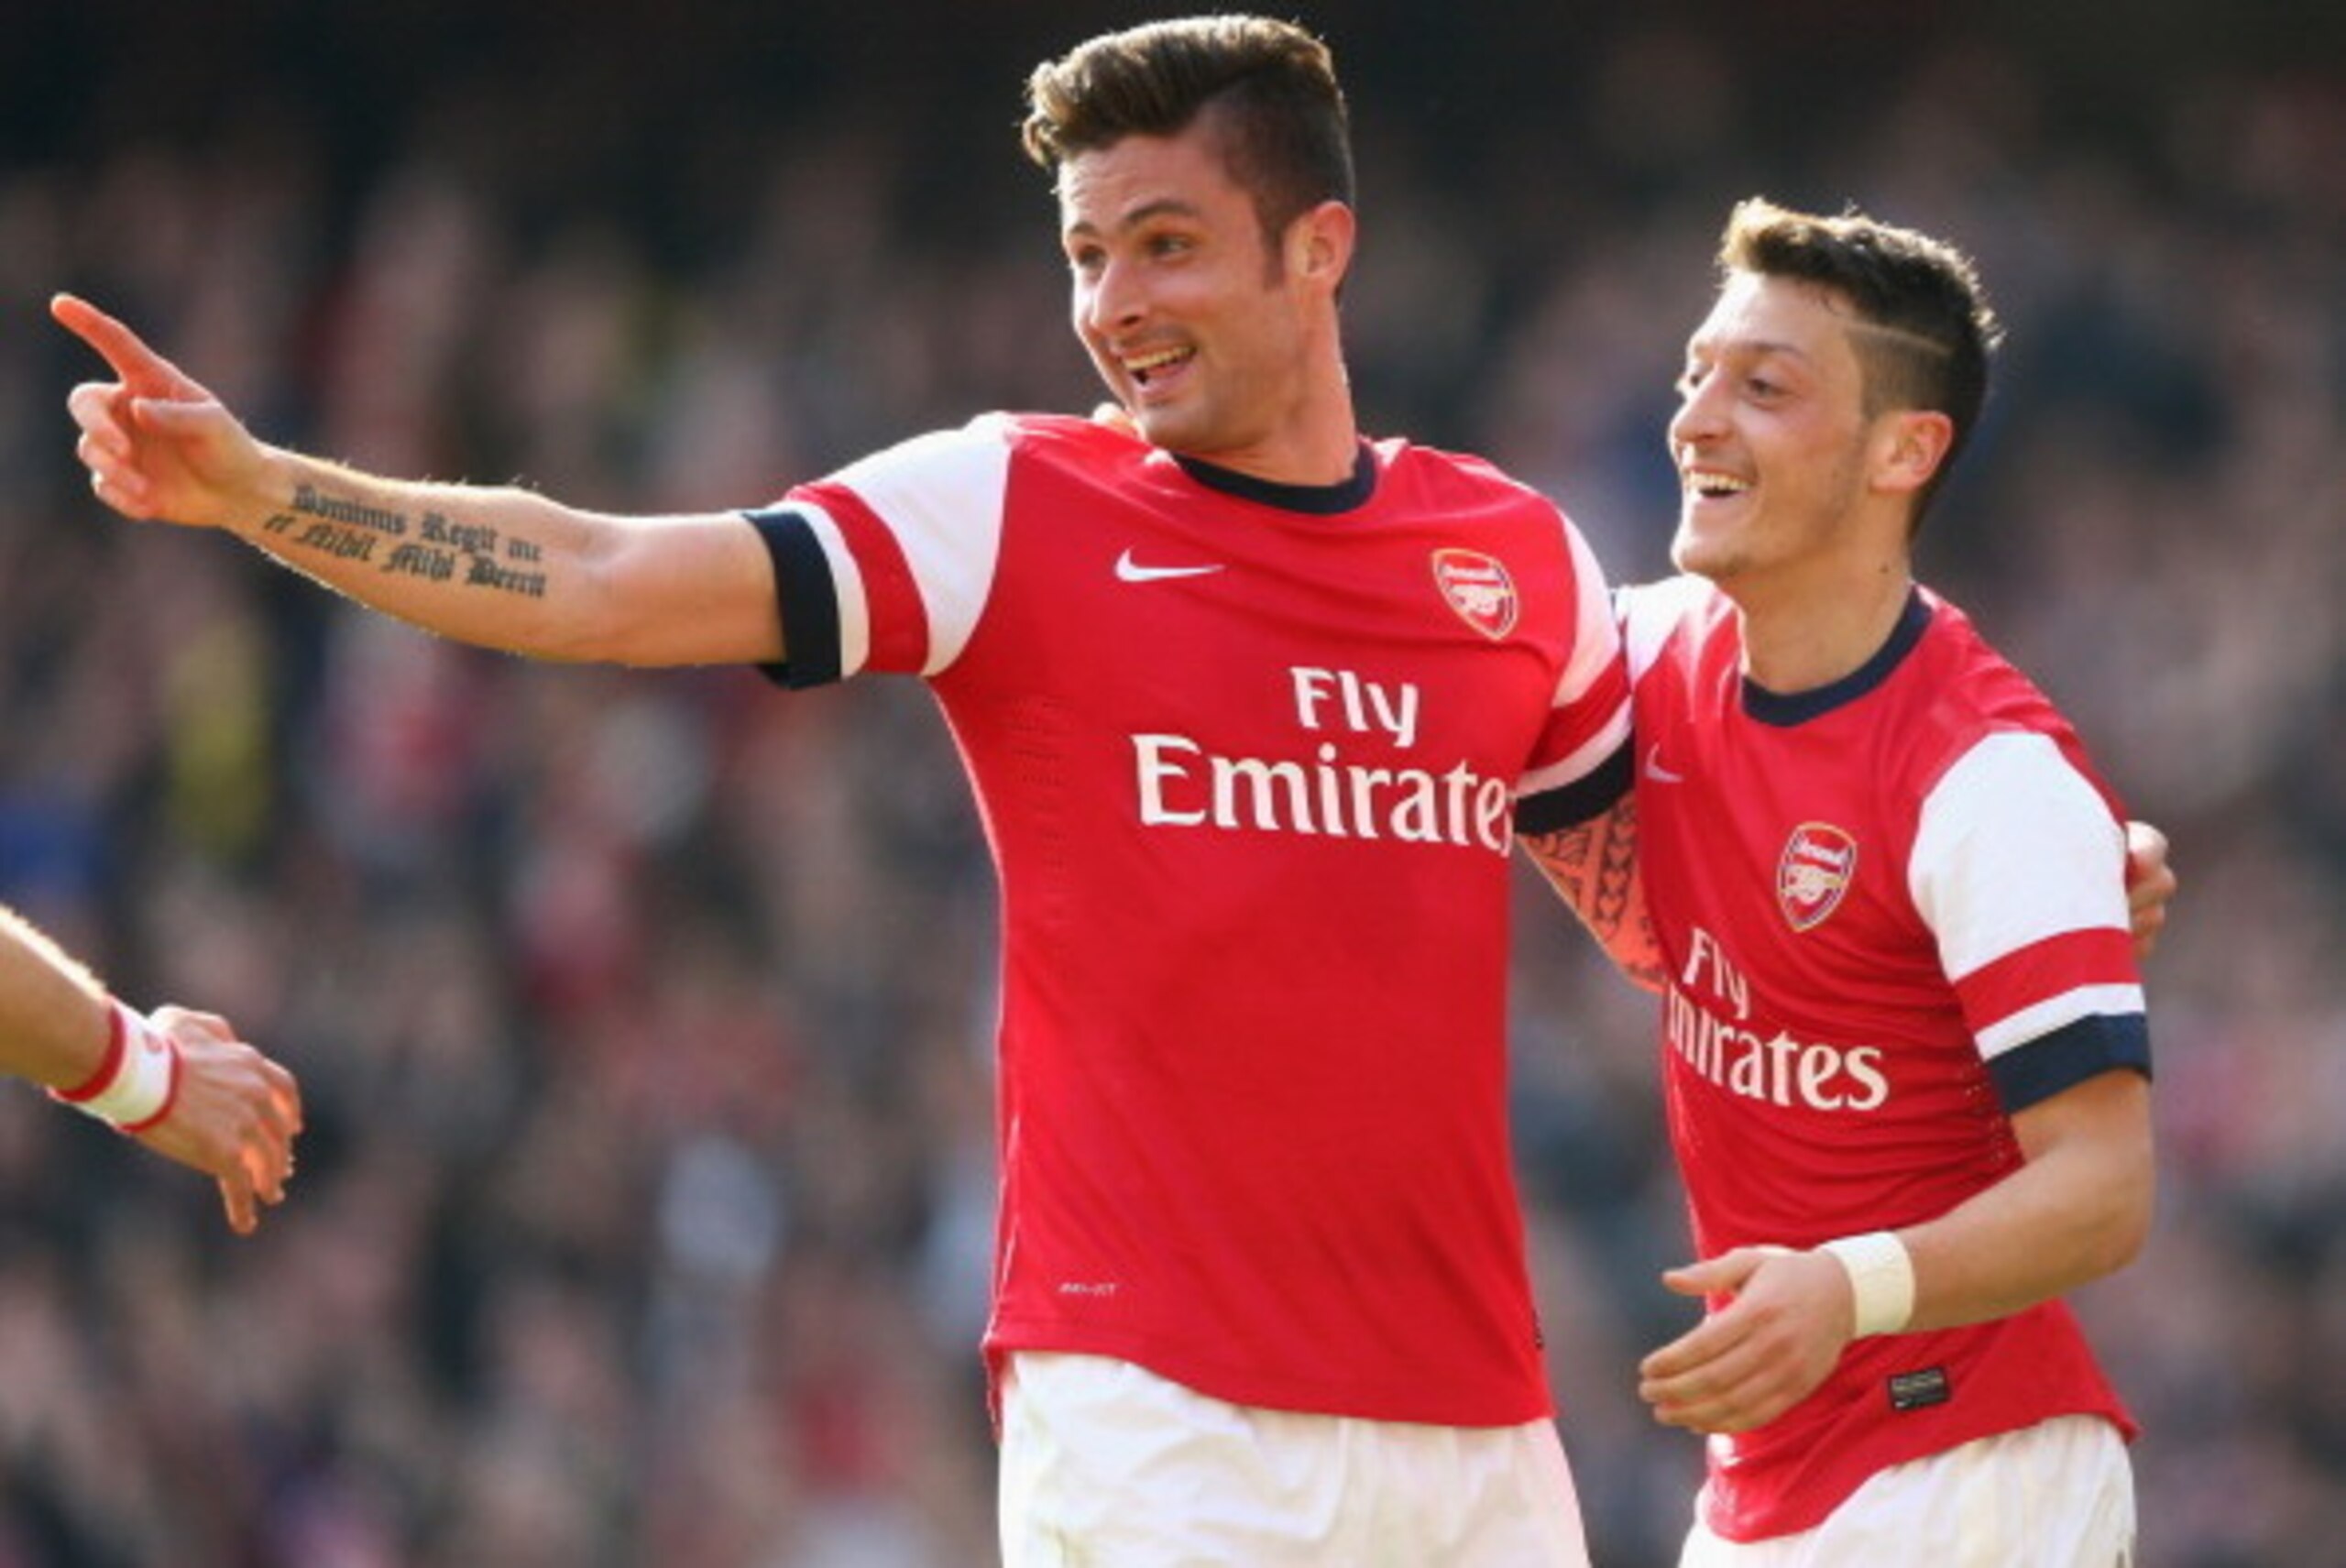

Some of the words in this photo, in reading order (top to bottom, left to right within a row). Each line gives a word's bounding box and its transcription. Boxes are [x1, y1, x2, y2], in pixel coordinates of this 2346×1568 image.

[1289, 665, 1419, 749] Fly
[1682, 927, 1750, 1020] Fly
[1668, 981, 1890, 1112] mirates
